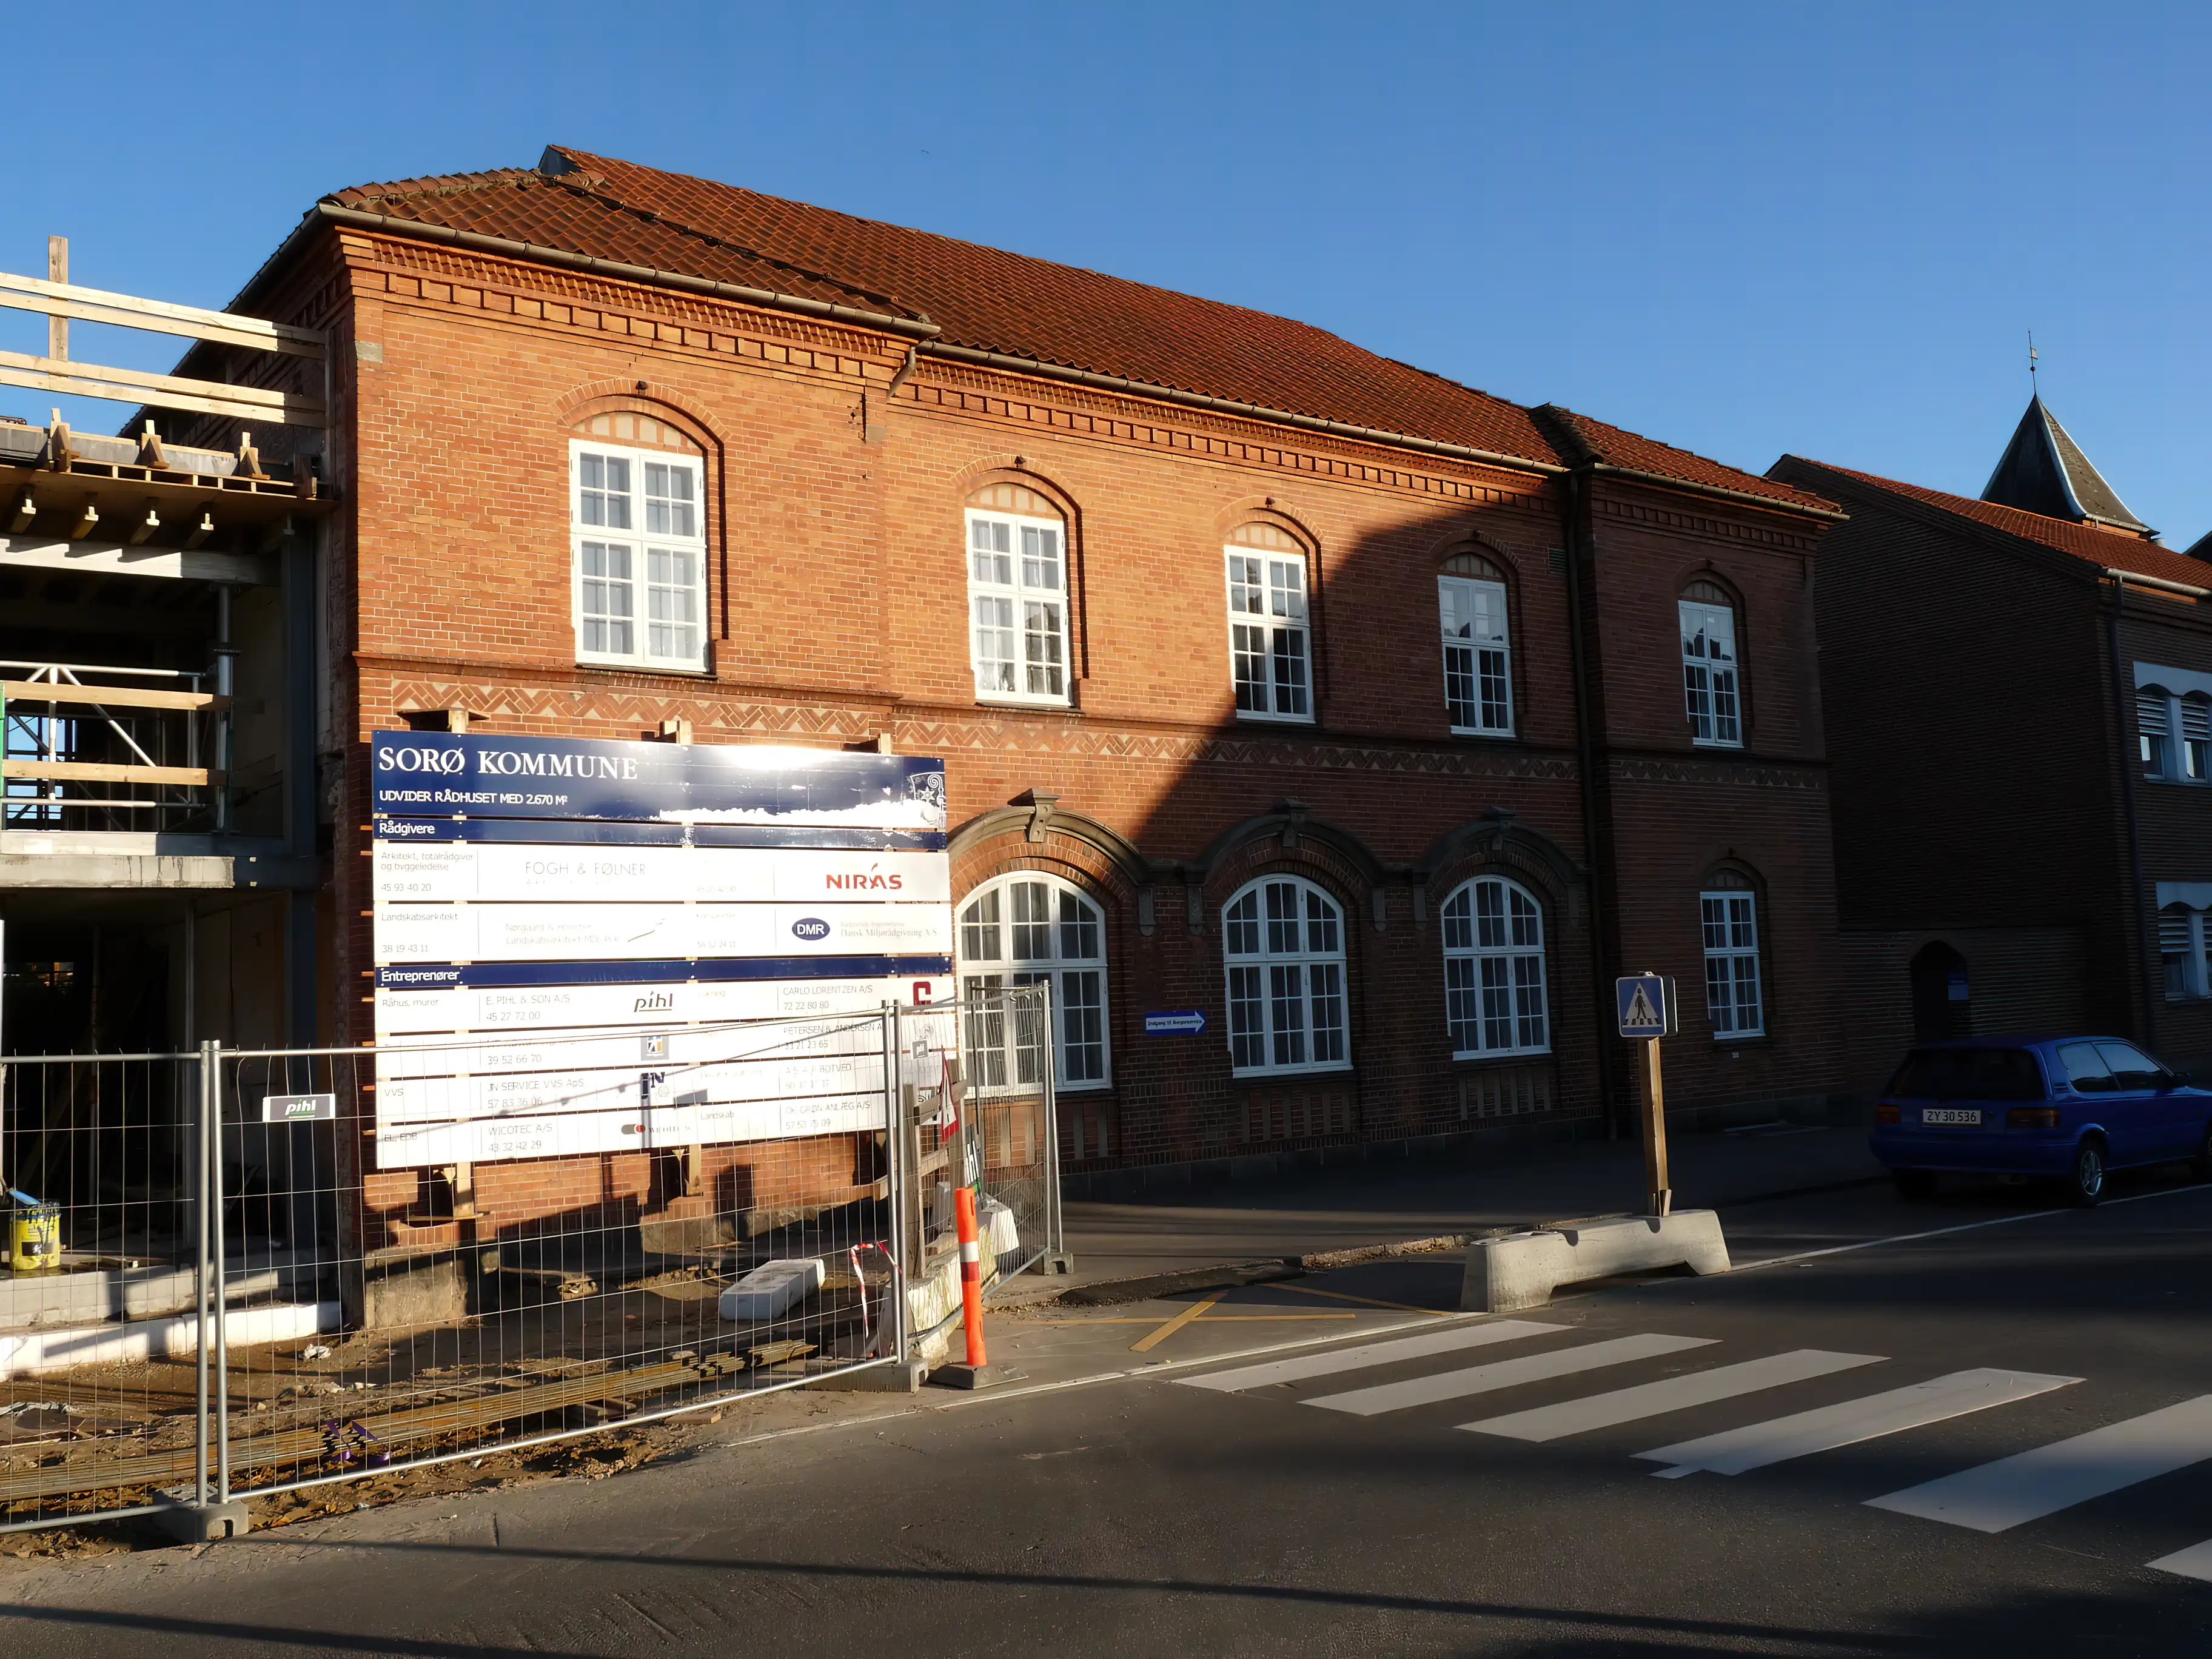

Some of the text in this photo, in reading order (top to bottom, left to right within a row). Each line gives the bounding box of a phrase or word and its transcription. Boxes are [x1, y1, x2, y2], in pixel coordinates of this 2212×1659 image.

[379, 747, 638, 780] SORØ KOMMUNE
[380, 790, 432, 802] UDVIDER
[435, 789, 497, 804] RÅDHUSET
[500, 793, 523, 805] MED
[380, 820, 435, 836] Rådgivere
[381, 850, 473, 862] Arkitekt, totalrådgiver
[381, 862, 449, 872] og byggeledelse
[526, 862, 645, 876] FOGH & FØLNER
[381, 912, 459, 922] Landskabsarkitekt
[797, 923, 825, 935] DMR
[840, 928, 863, 937] Dansk
[382, 944, 428, 953] 38 19 43 11
[381, 971, 460, 983] Entreprenører
[783, 987, 810, 995] CARLO
[812, 985, 857, 994] LORENTZEN
[382, 997, 410, 1007] Råhus,
[497, 996, 517, 1005] PIHL
[520, 996, 527, 1004] &
[531, 994, 551, 1004] SON
[554, 994, 571, 1003] A/S
[633, 990, 674, 1013] pihl
[819, 1000, 829, 1009] 80
[486, 1011, 540, 1021] 45 27 72 00
[783, 1025, 823, 1034] PETERSEN
[835, 1023, 875, 1032] ANDERSEN
[796, 1041, 804, 1050] 21
[807, 1041, 816, 1049] 23
[819, 1040, 828, 1048] 65
[488, 1054, 541, 1065] 39 52 66 70
[820, 1063, 851, 1073] BOTVED
[501, 1081, 540, 1091] SERVICE
[543, 1079, 563, 1088] VVS
[566, 1079, 584, 1088] ApS
[384, 1088, 404, 1096] VVS
[285, 1099, 317, 1116] pihl
[488, 1097, 543, 1109] 57 83 36 06
[825, 1102, 854, 1111] ANLÆG
[857, 1101, 871, 1110] A/S
[701, 1111, 734, 1120] Landskab
[1927, 1111, 1976, 1122] ZY 30 536
[821, 1118, 831, 1127] 09
[488, 1124, 552, 1135] WICOTEC A/S
[384, 1134, 397, 1143] EL,
[488, 1140, 541, 1152] 43 32 42 29
